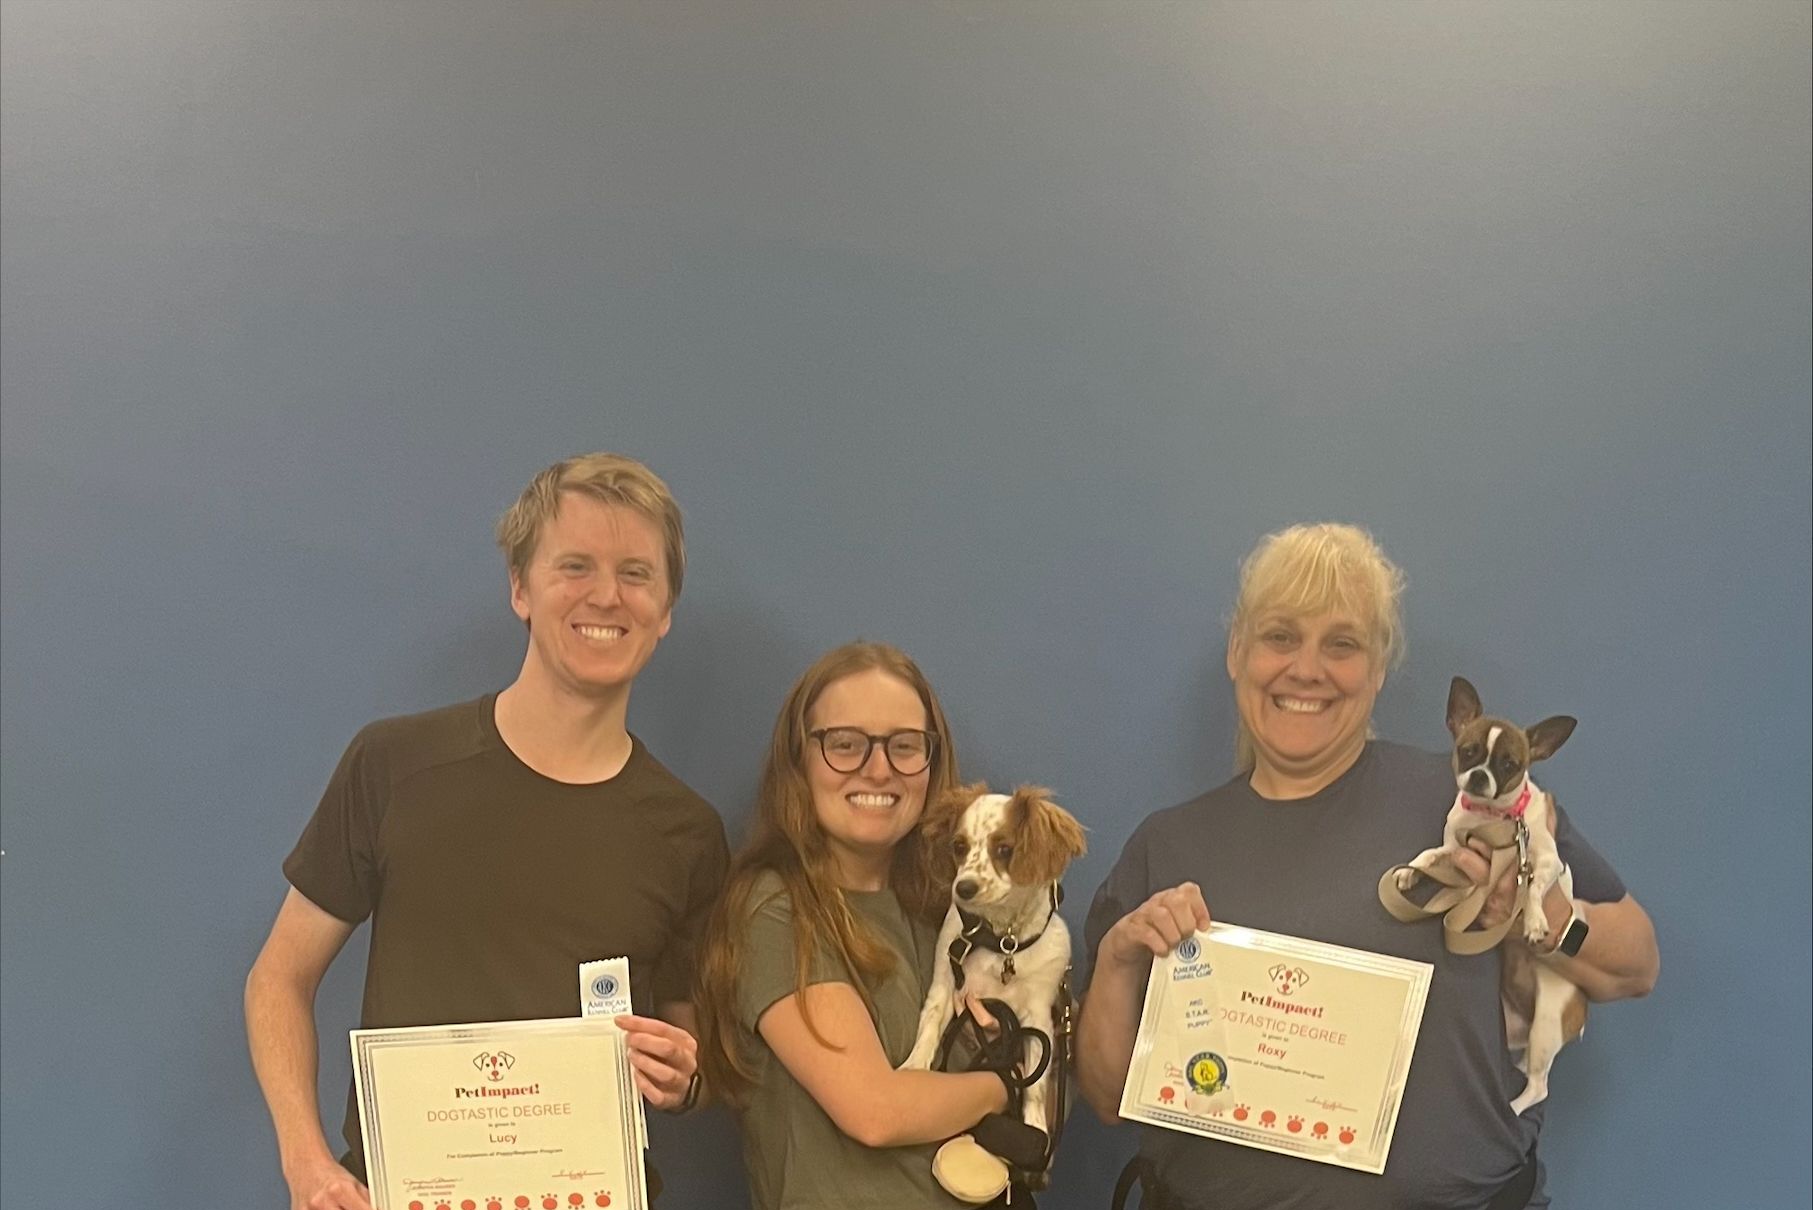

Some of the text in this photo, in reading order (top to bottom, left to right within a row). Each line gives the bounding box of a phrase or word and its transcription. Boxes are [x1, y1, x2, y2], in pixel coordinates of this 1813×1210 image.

[1240, 991, 1324, 1019] PetImpact!
[1220, 1008, 1348, 1046] OGTASTIC DEGREE
[1257, 1042, 1288, 1059] Roxy
[454, 1083, 541, 1099] PetImpact!
[427, 1103, 572, 1123] DOGTASTIC DEGREE
[489, 1133, 518, 1145] Lucy
